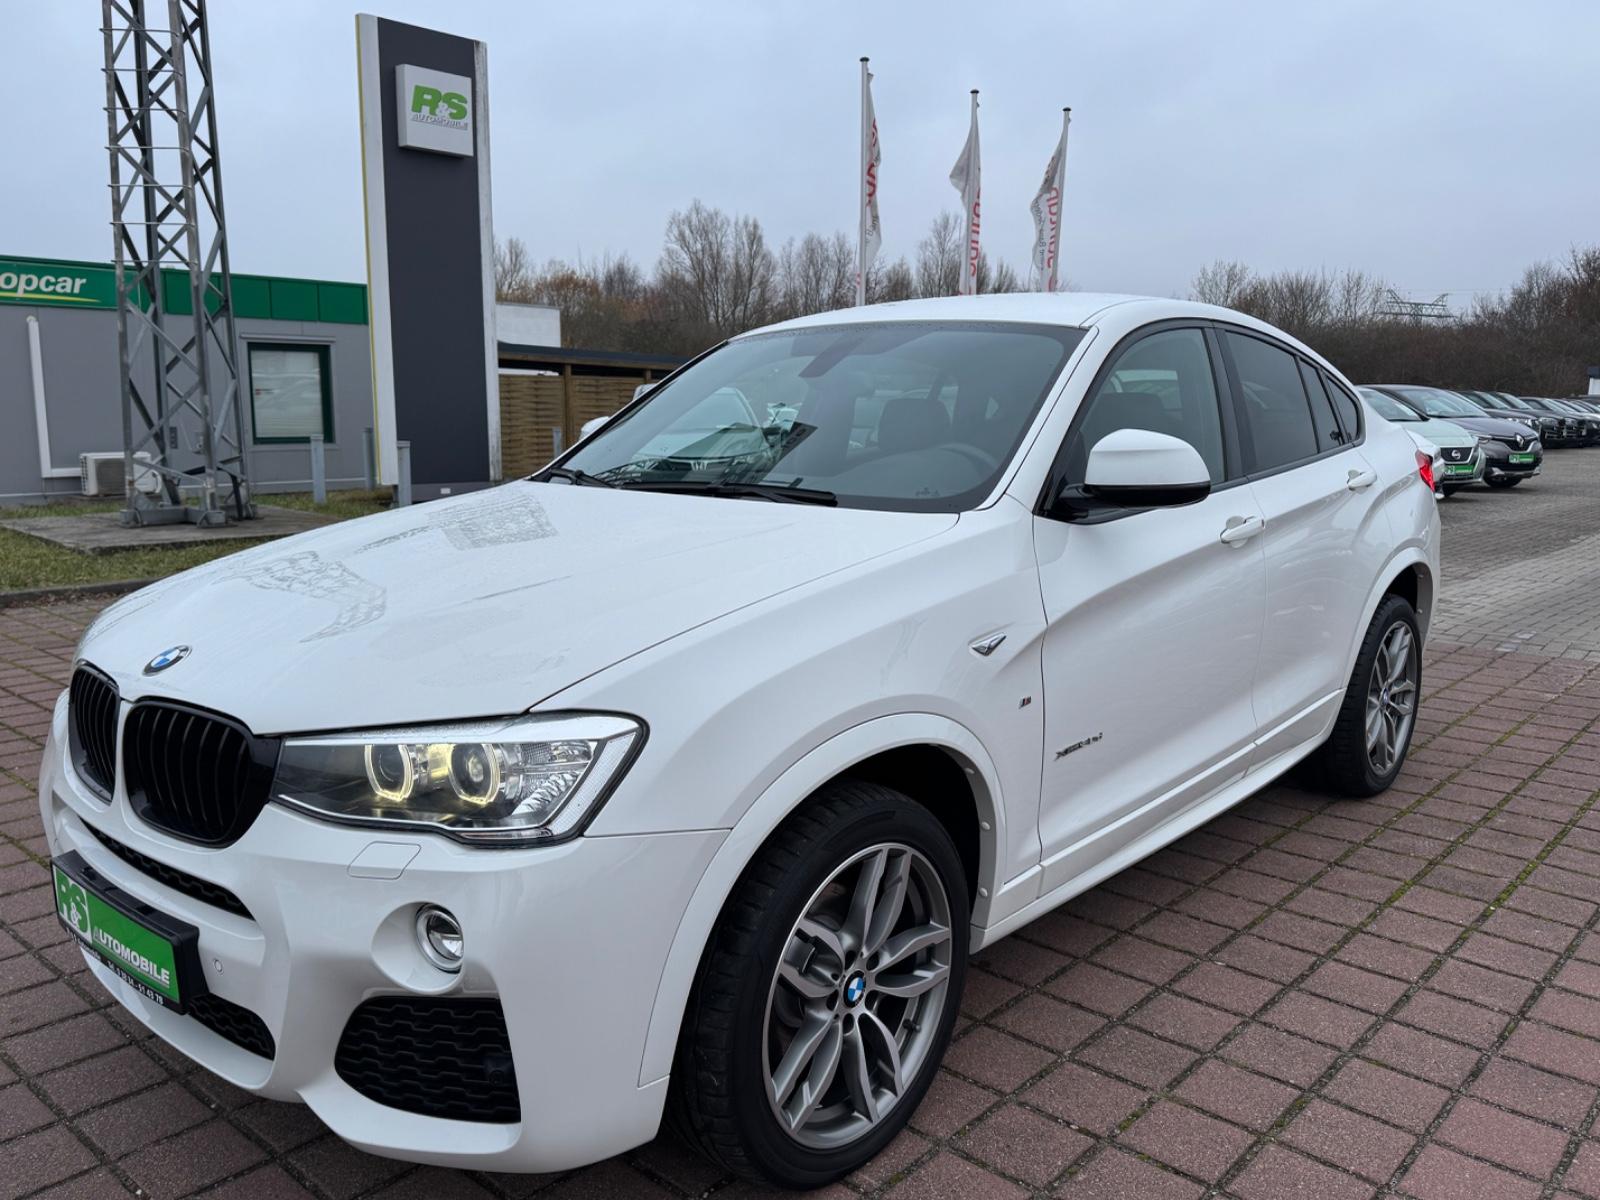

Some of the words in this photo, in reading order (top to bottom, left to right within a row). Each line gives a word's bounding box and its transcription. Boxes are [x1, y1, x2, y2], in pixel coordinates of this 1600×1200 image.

[411, 84, 468, 120] R&S
[0, 272, 87, 298] opcar
[56, 867, 89, 935] R&S
[94, 926, 170, 986] AUTOMOBILE
